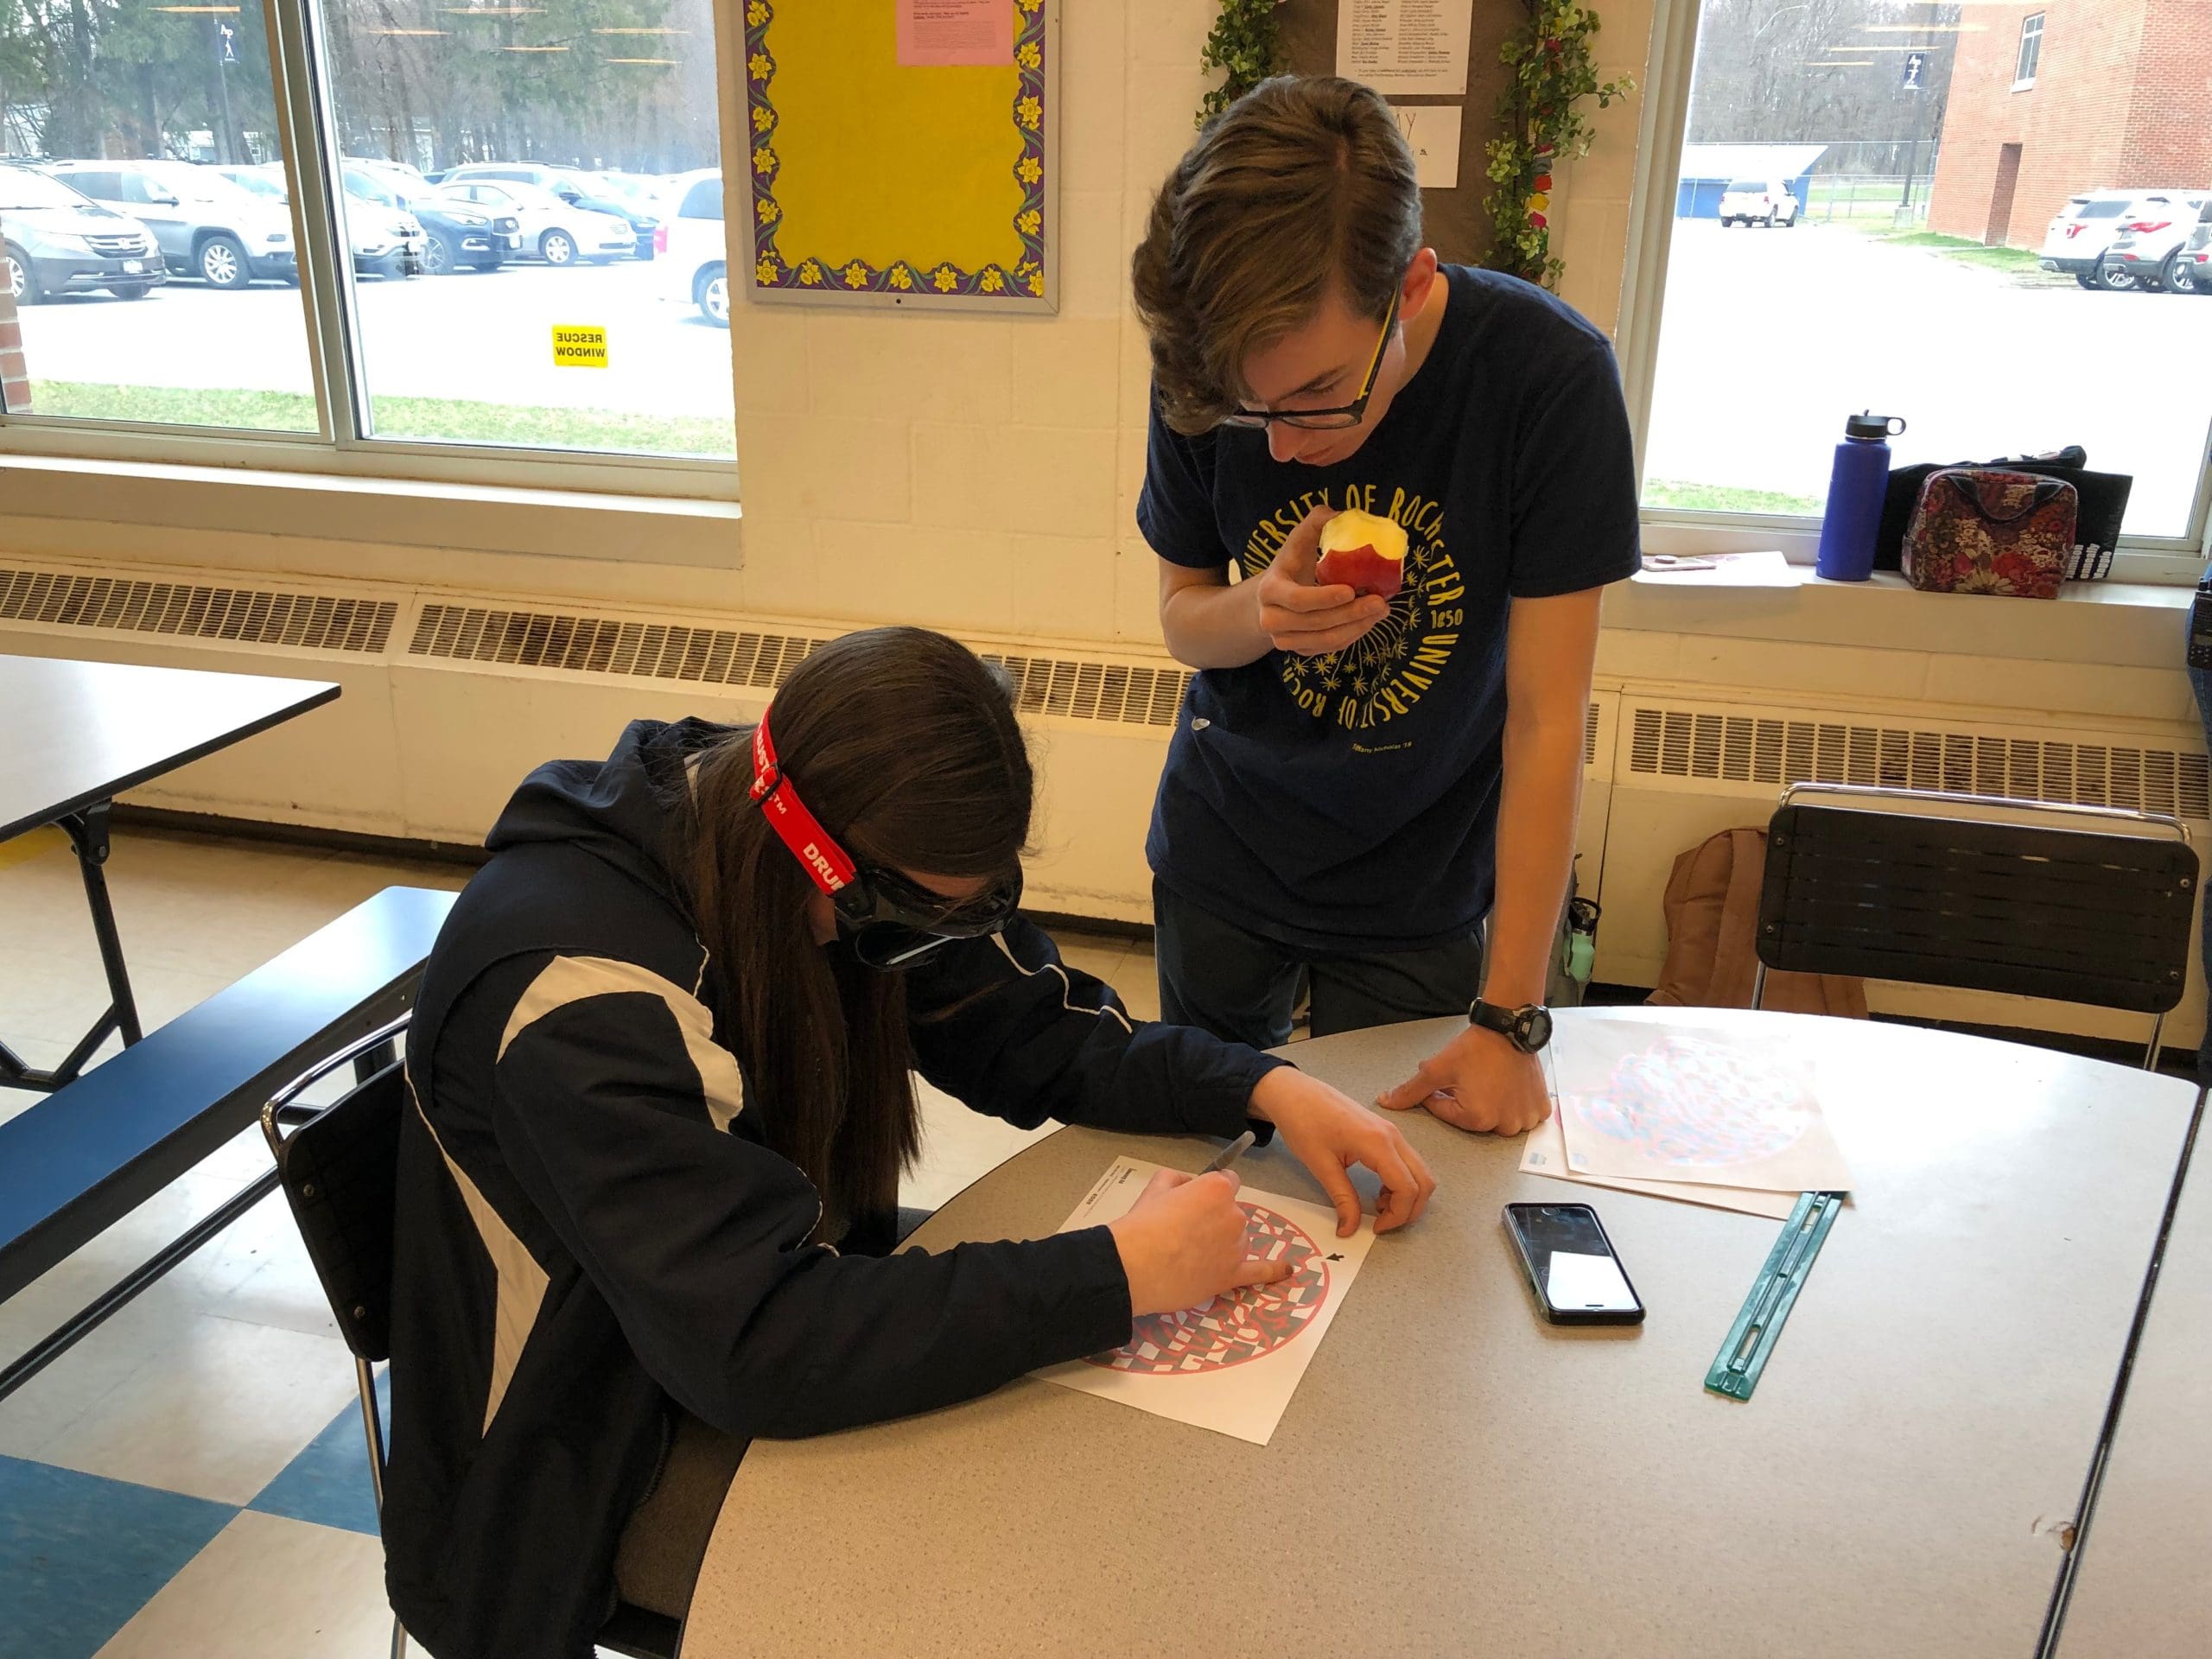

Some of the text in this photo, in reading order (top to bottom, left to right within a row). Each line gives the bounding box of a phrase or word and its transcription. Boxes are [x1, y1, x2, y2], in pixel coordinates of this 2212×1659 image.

[1345, 484, 1377, 512] OF
[1431, 608, 1463, 629] 1850
[1356, 633, 1459, 728] UNIVERSIT
